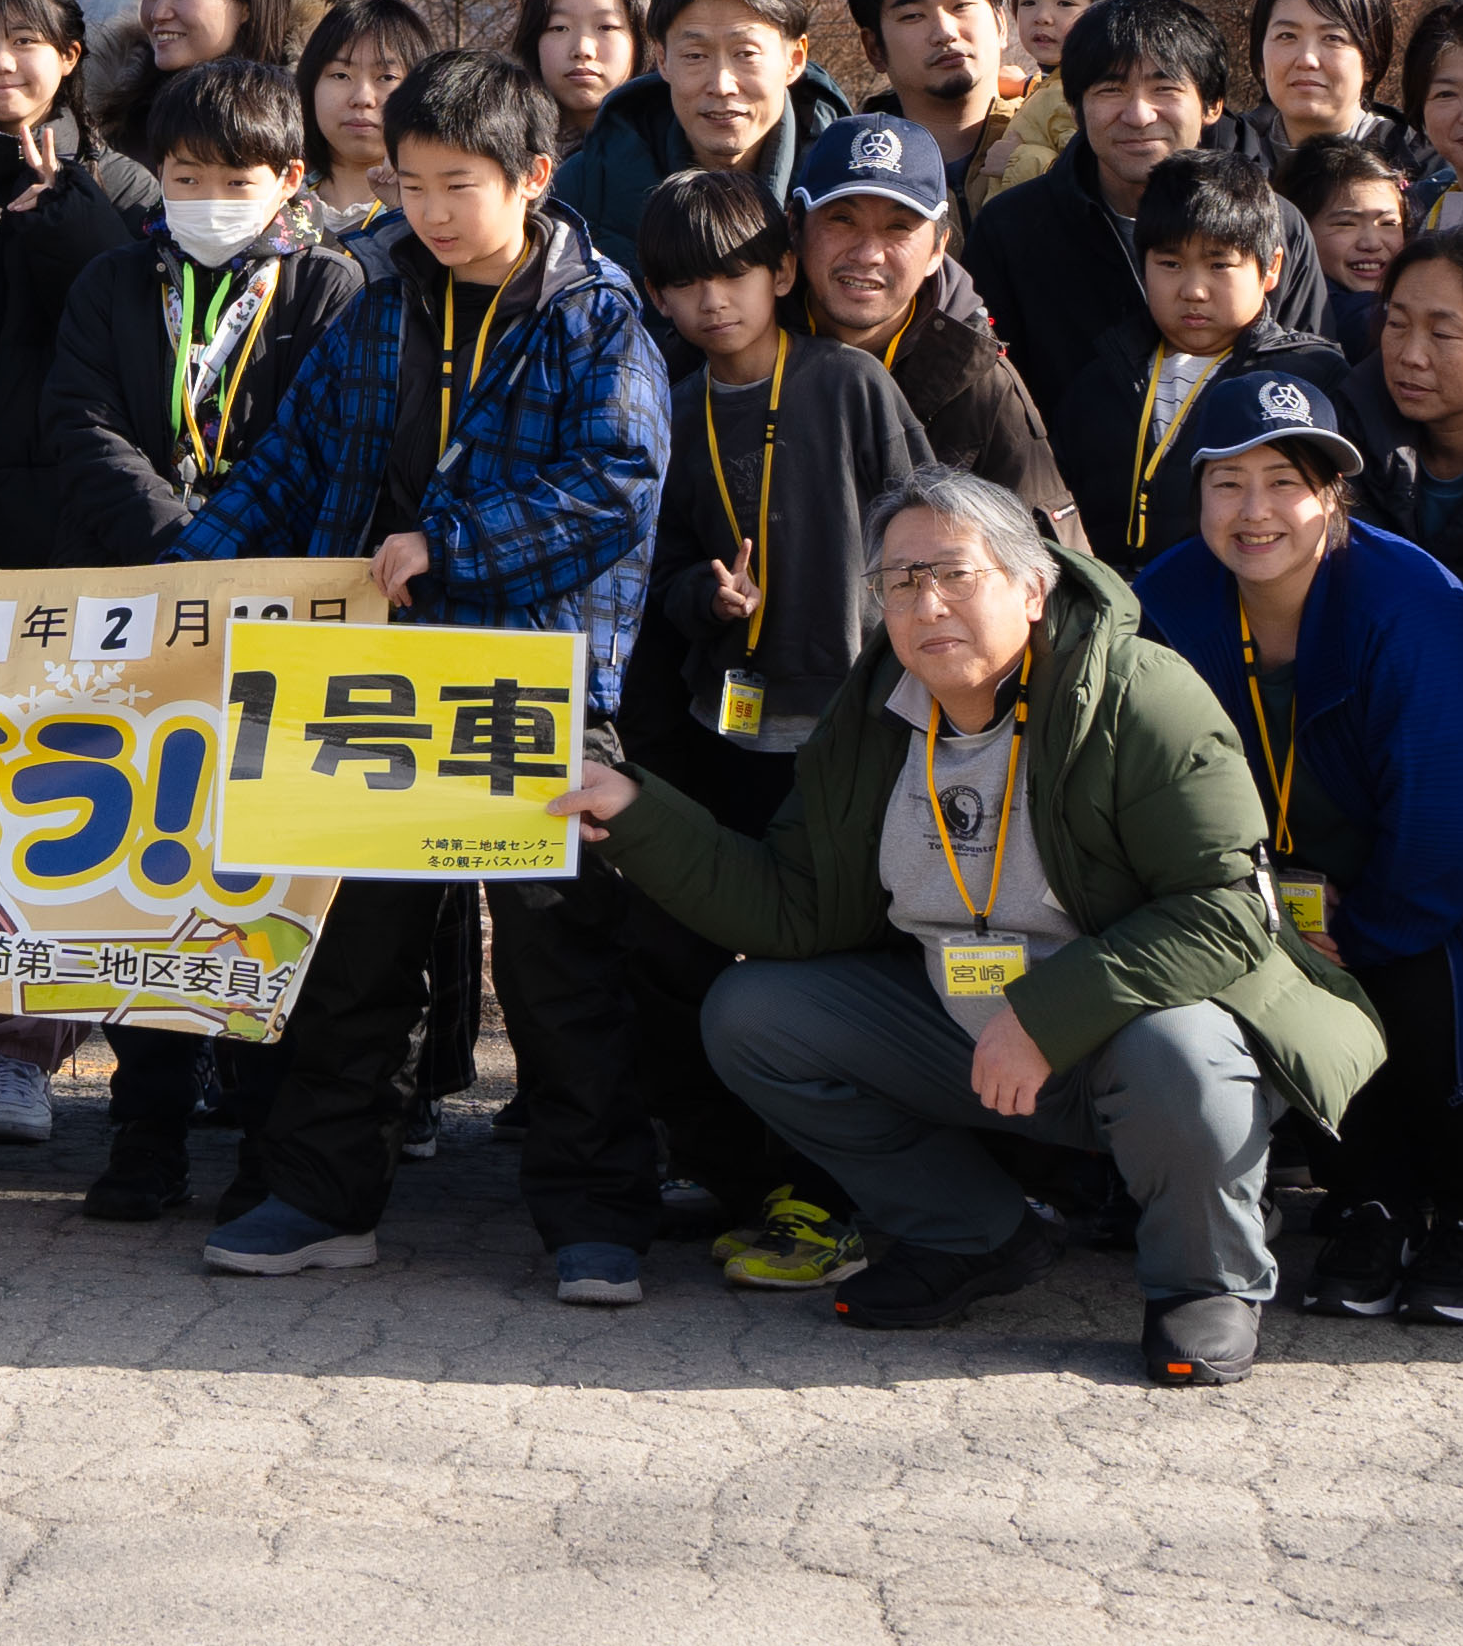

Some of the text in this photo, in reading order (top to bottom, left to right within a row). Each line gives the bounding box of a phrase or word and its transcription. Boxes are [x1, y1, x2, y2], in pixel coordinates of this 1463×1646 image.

[228, 670, 570, 796] 1号車
[421, 837, 564, 852] 大崎第二地域センター
[427, 854, 555, 868] 冬の親子バスハイク
[950, 963, 1006, 983] 宮崎
